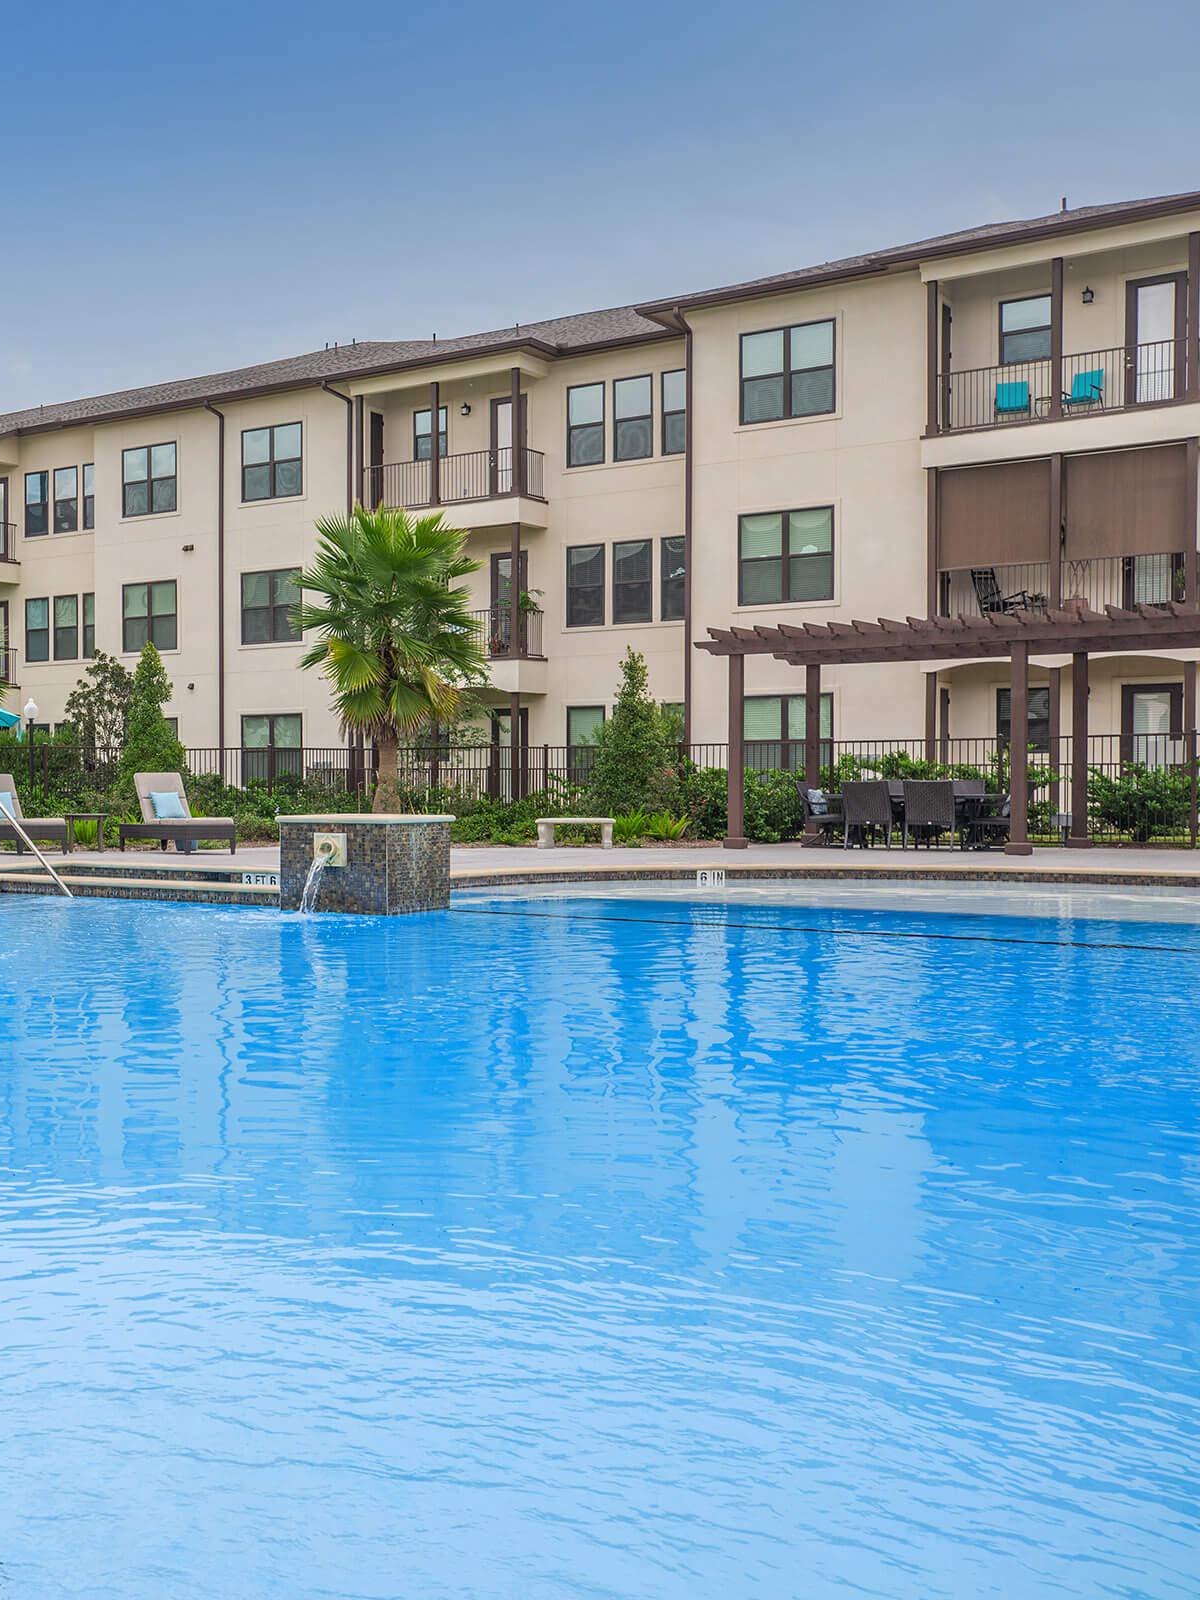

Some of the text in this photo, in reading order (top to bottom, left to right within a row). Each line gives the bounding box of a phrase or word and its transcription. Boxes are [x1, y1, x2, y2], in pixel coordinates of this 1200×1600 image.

[246, 874, 276, 885] 3 FT 6
[700, 871, 723, 882] 6 IN
